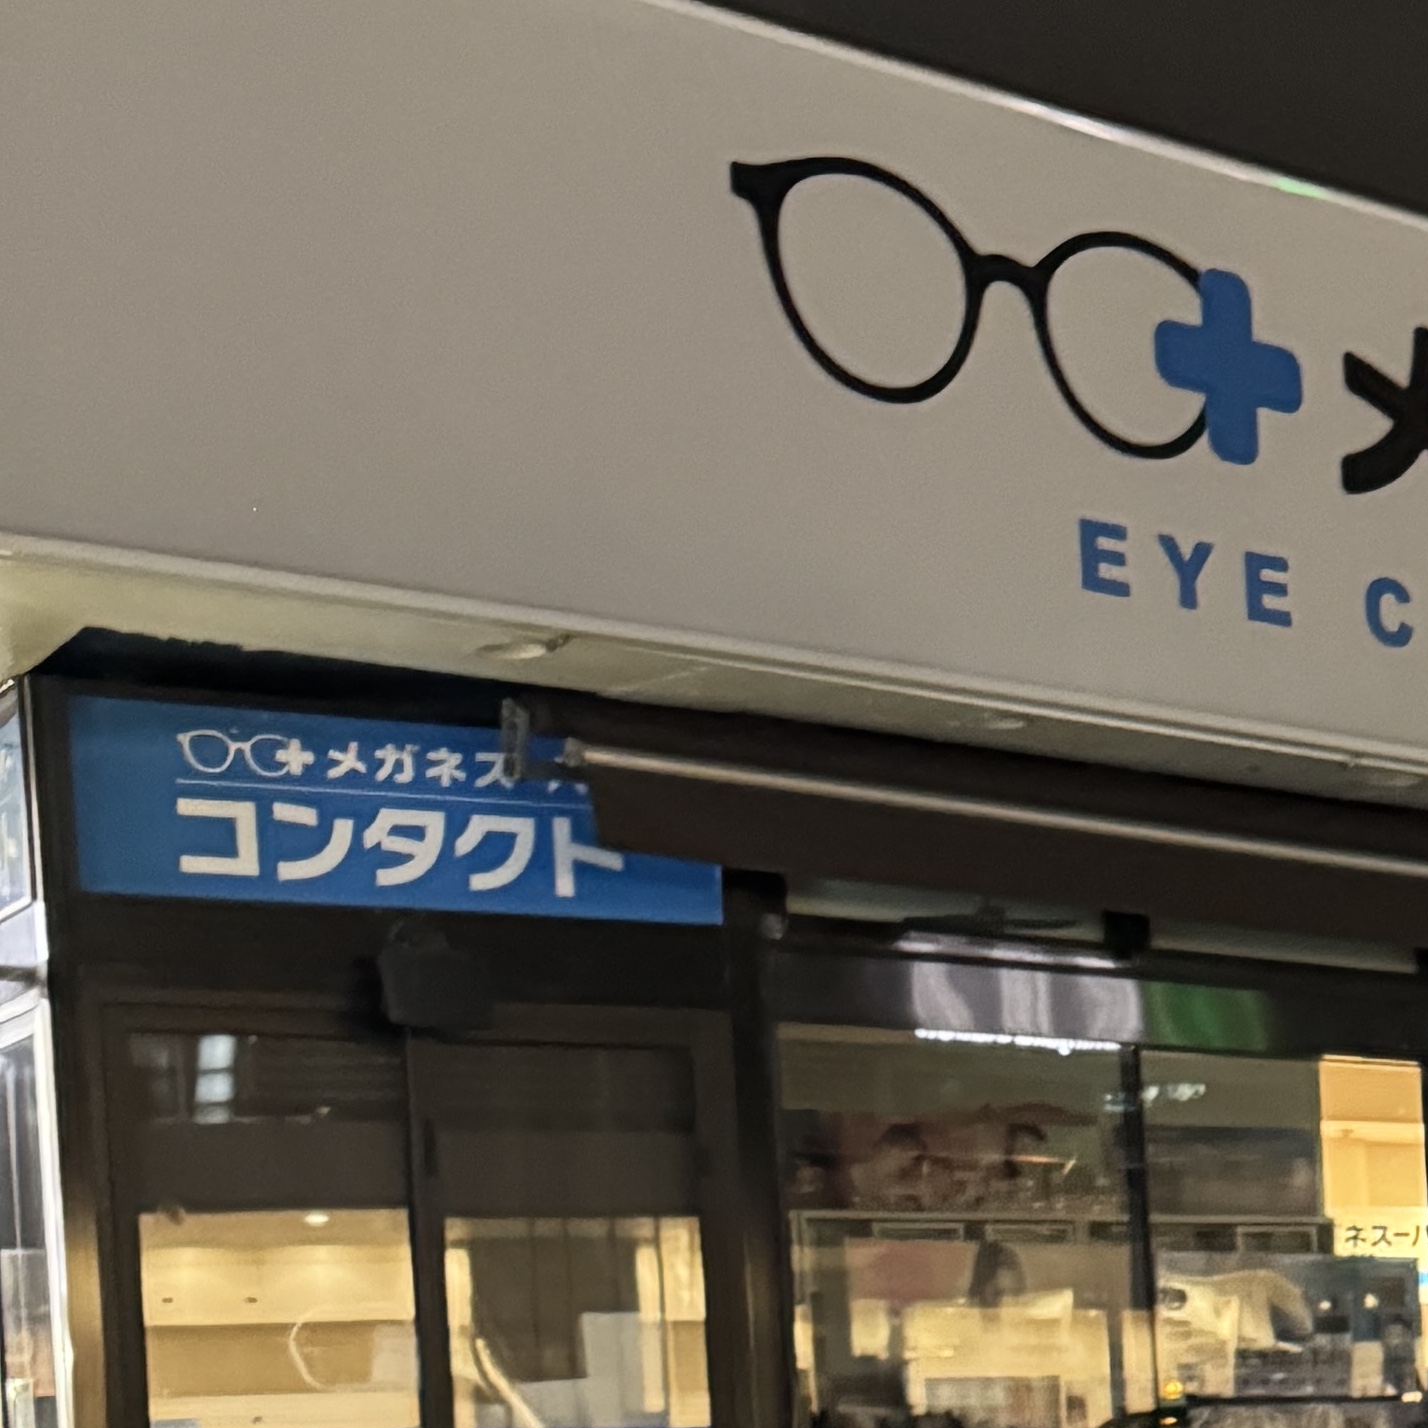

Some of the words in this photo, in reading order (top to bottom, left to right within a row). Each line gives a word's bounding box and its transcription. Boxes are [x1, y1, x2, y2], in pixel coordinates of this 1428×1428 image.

[1078, 517, 1294, 628] EYE
[176, 797, 625, 898] コンタクト
